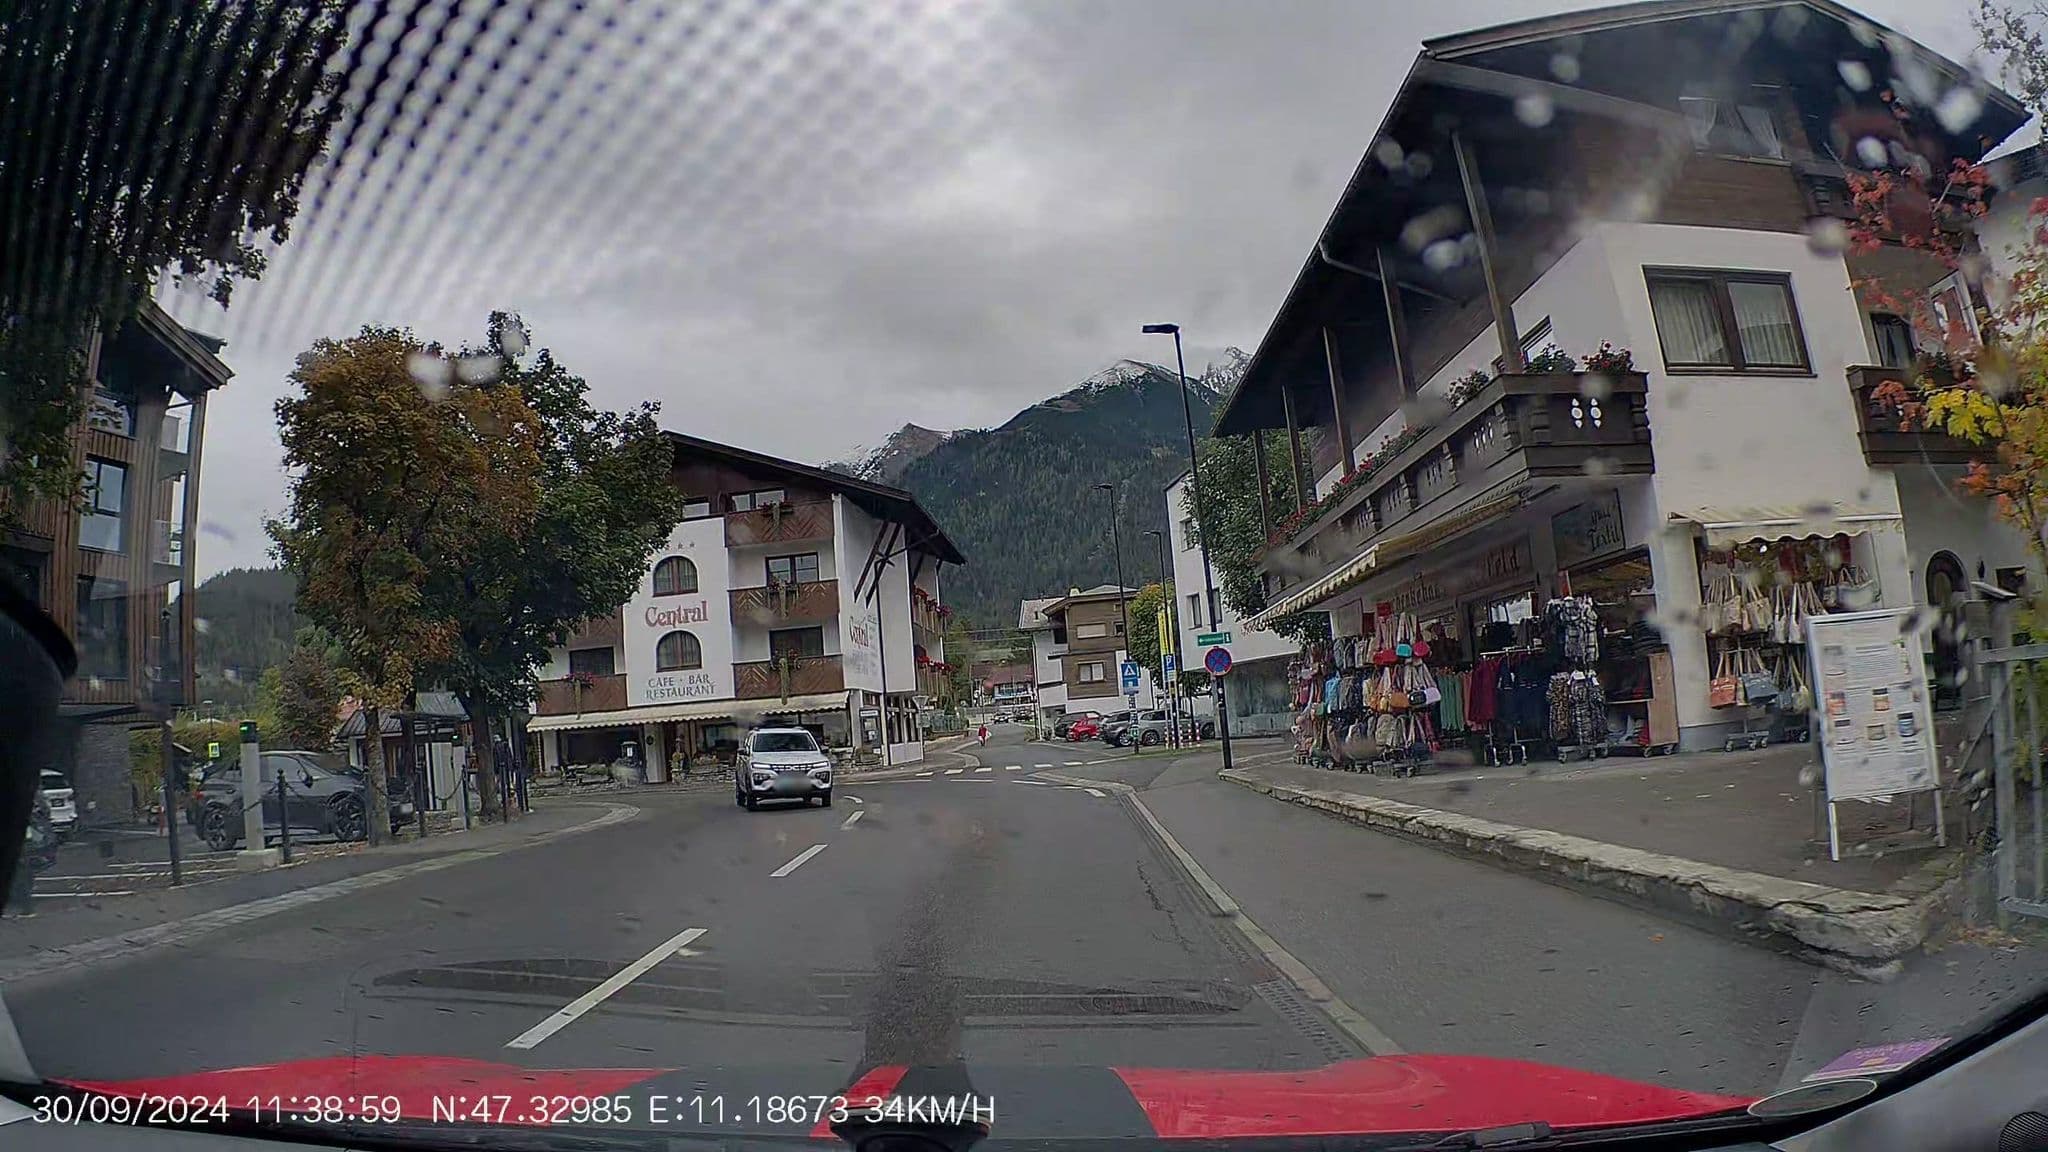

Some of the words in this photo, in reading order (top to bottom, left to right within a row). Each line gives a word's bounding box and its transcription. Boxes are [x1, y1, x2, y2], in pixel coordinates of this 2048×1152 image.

[645, 601, 709, 629] Central
[648, 676, 675, 688] CAFE
[688, 673, 711, 686] BAR
[646, 682, 717, 701] RESTAURANT
